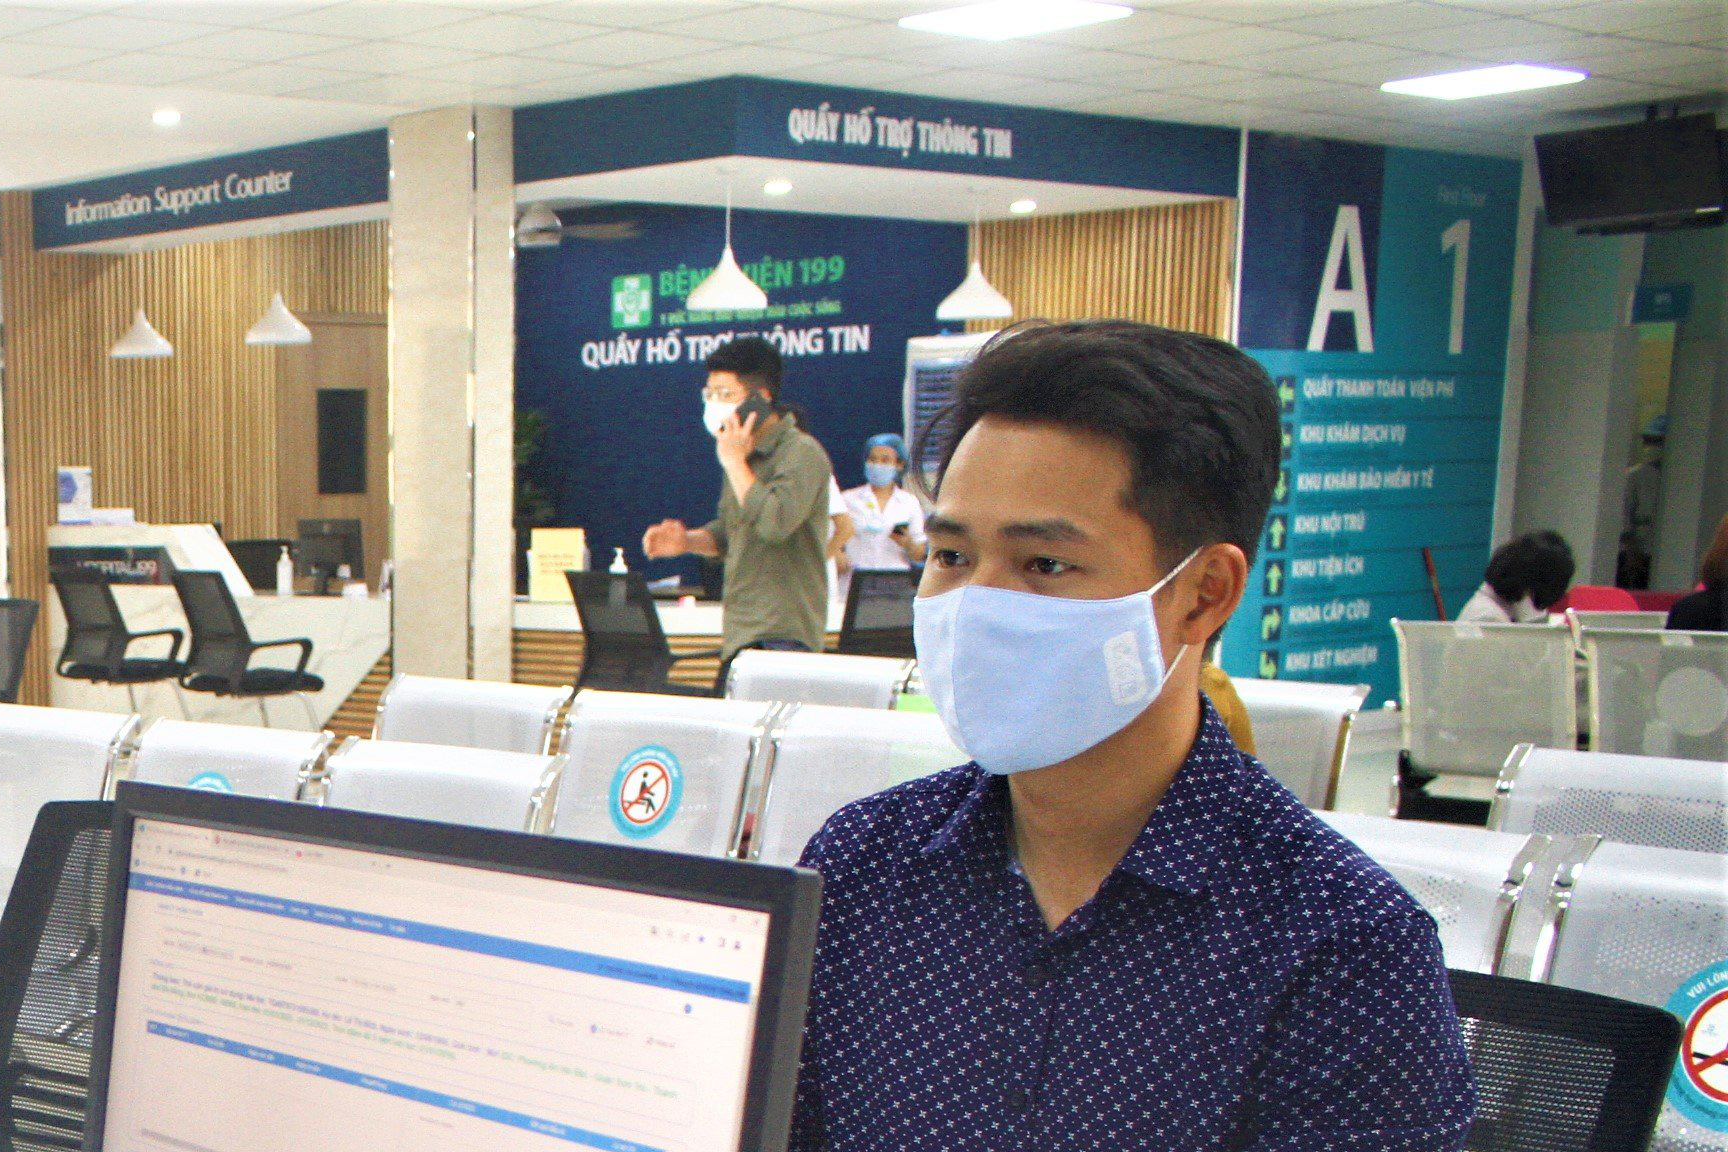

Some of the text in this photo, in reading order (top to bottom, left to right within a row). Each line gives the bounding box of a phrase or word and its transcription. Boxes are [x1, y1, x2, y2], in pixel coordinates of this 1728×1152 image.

[876, 116, 914, 157] TRỢ
[917, 117, 979, 155] THÔNG
[982, 127, 1012, 158] TIN
[65, 170, 293, 225] Information Support Counter
[660, 255, 845, 302] BỆN IỆN 199
[1306, 205, 1373, 352] A
[1441, 219, 1471, 354] 1
[828, 325, 870, 353] TIN
[1686, 981, 1706, 998] VUI
